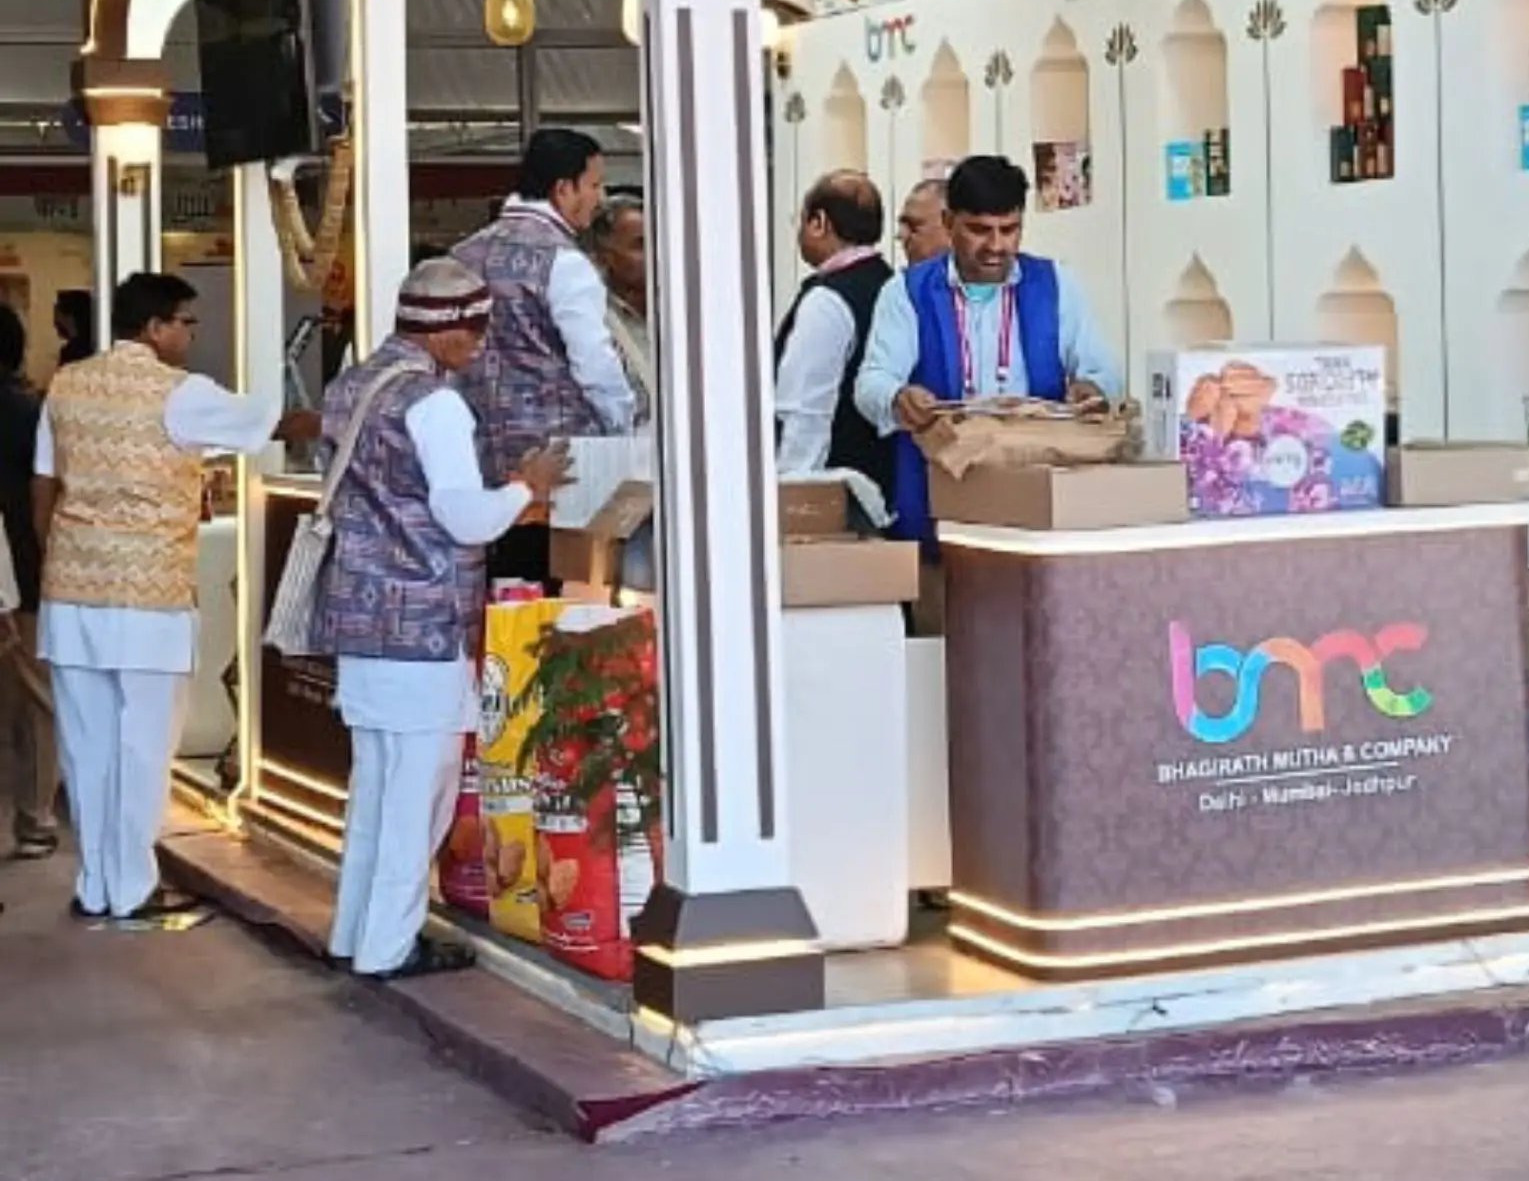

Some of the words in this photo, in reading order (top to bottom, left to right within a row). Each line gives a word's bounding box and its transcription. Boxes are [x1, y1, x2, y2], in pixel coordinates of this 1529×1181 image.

[1169, 621, 1434, 743] bmc
[1158, 753, 1268, 784] BHAGIRATH
[1273, 747, 1339, 770] MUTHA
[1343, 744, 1357, 764] &
[1360, 732, 1452, 762] COMPANY
[1199, 790, 1245, 812] Delhi
